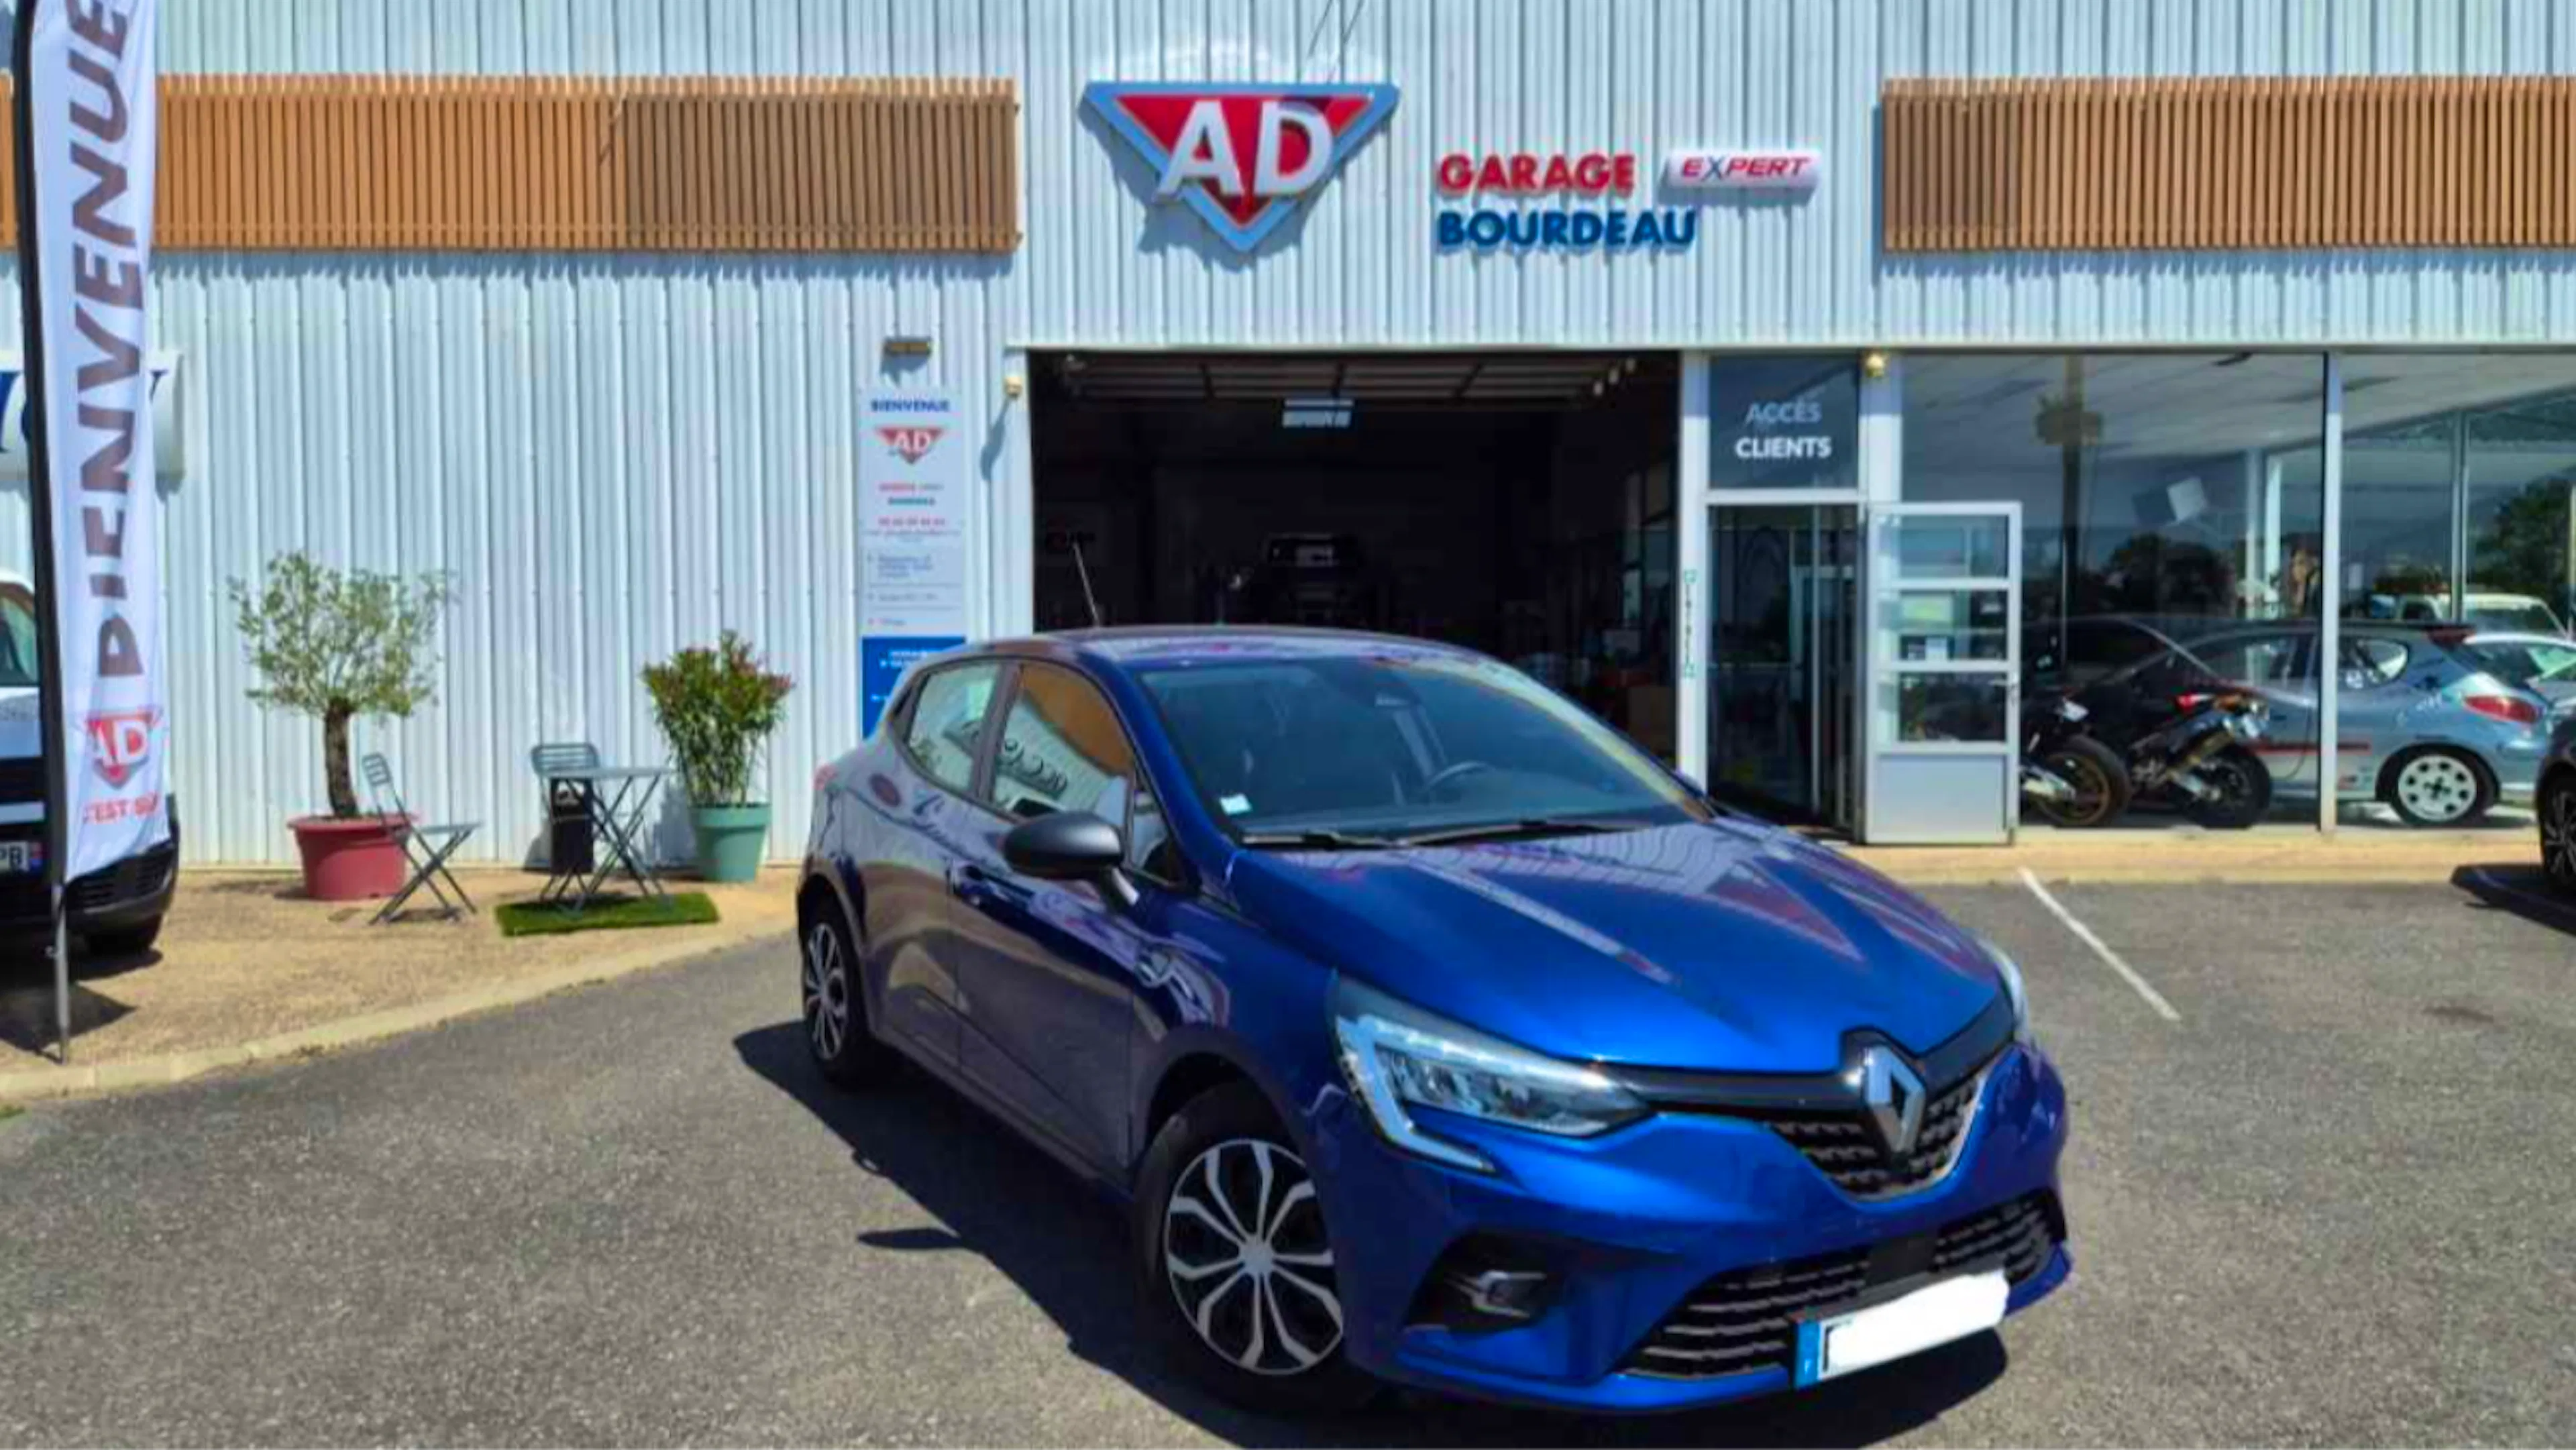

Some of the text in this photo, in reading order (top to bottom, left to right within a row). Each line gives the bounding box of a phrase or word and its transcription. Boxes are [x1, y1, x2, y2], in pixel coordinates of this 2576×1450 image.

[1154, 99, 1334, 198] AD
[1438, 154, 1635, 192] GARAGE
[1680, 156, 1811, 180] EXPERT
[1438, 209, 1696, 248] BOURDEAU
[871, 398, 950, 413] BIENVENUE
[1746, 395, 1822, 425] ACCÈS
[894, 429, 932, 453] AD
[1735, 436, 1833, 459] CLIENTS
